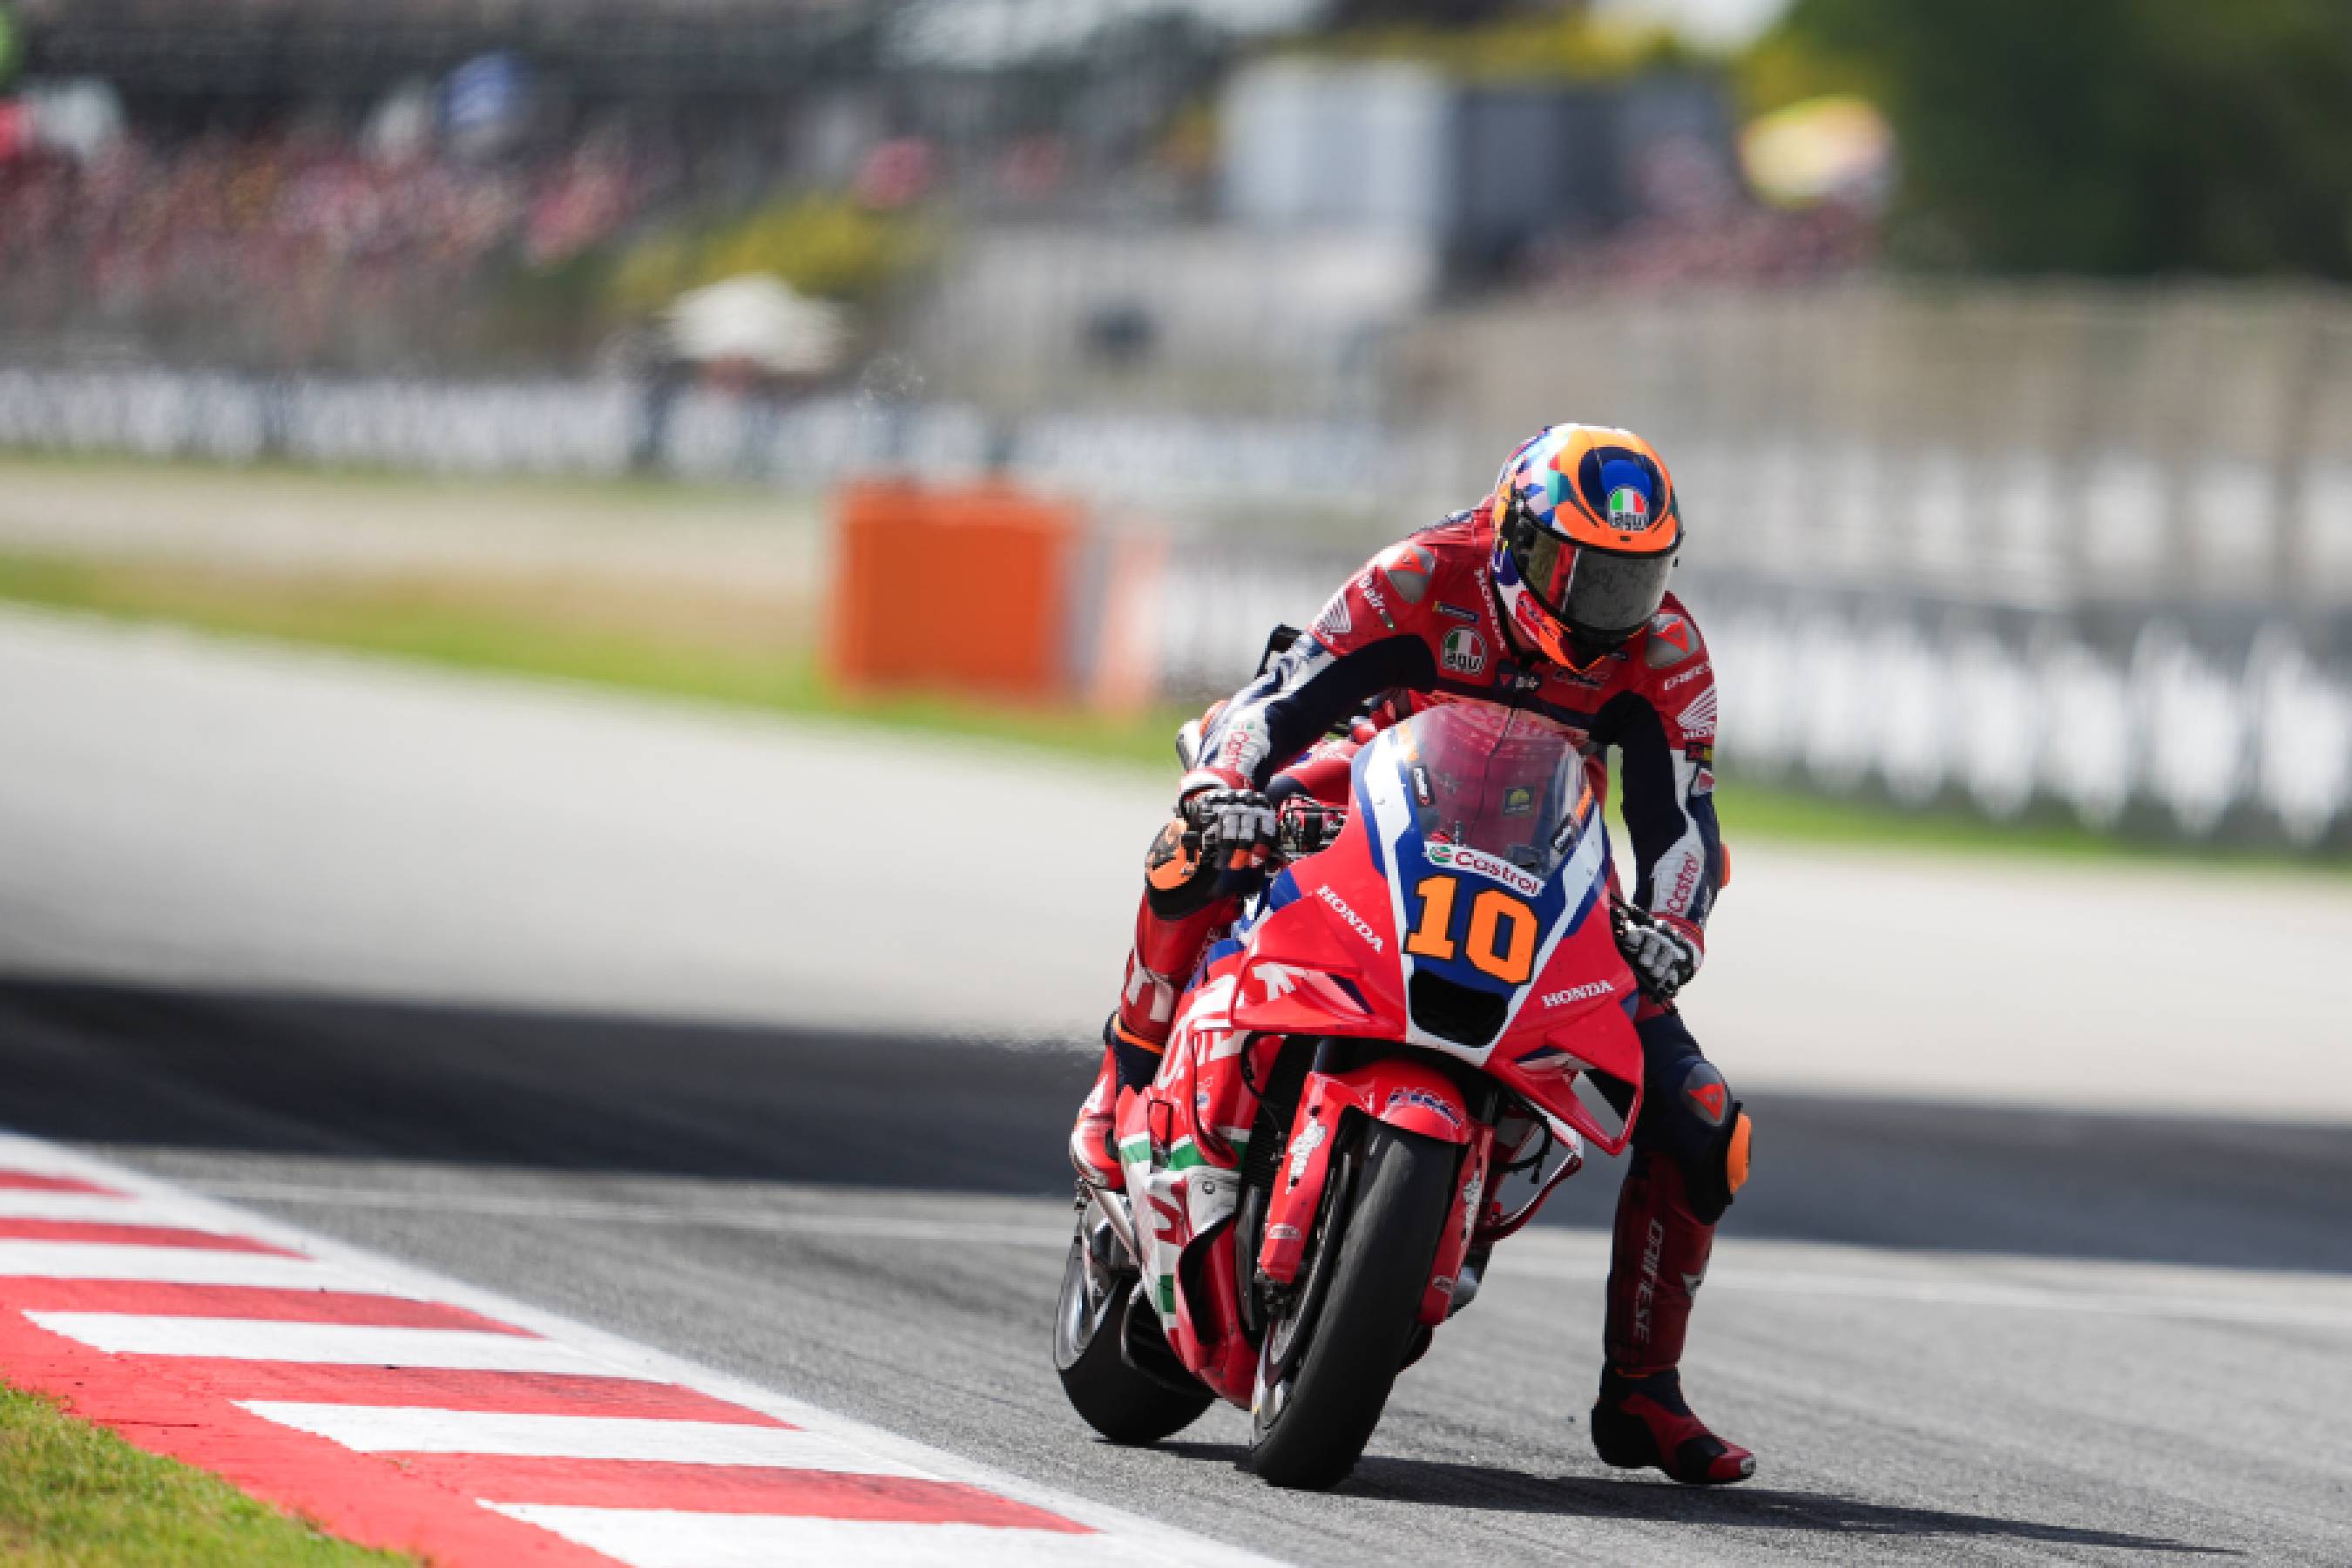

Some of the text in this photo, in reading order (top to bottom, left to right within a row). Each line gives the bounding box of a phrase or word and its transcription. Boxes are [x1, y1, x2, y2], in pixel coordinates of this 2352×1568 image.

[1446, 653, 1481, 674] agv
[1455, 852, 1538, 895] Castrol
[1666, 851, 1699, 914] Castrol
[1316, 885, 1384, 953] HONDA
[1404, 874, 1539, 985] 10
[1543, 980, 1614, 1009] HONDA
